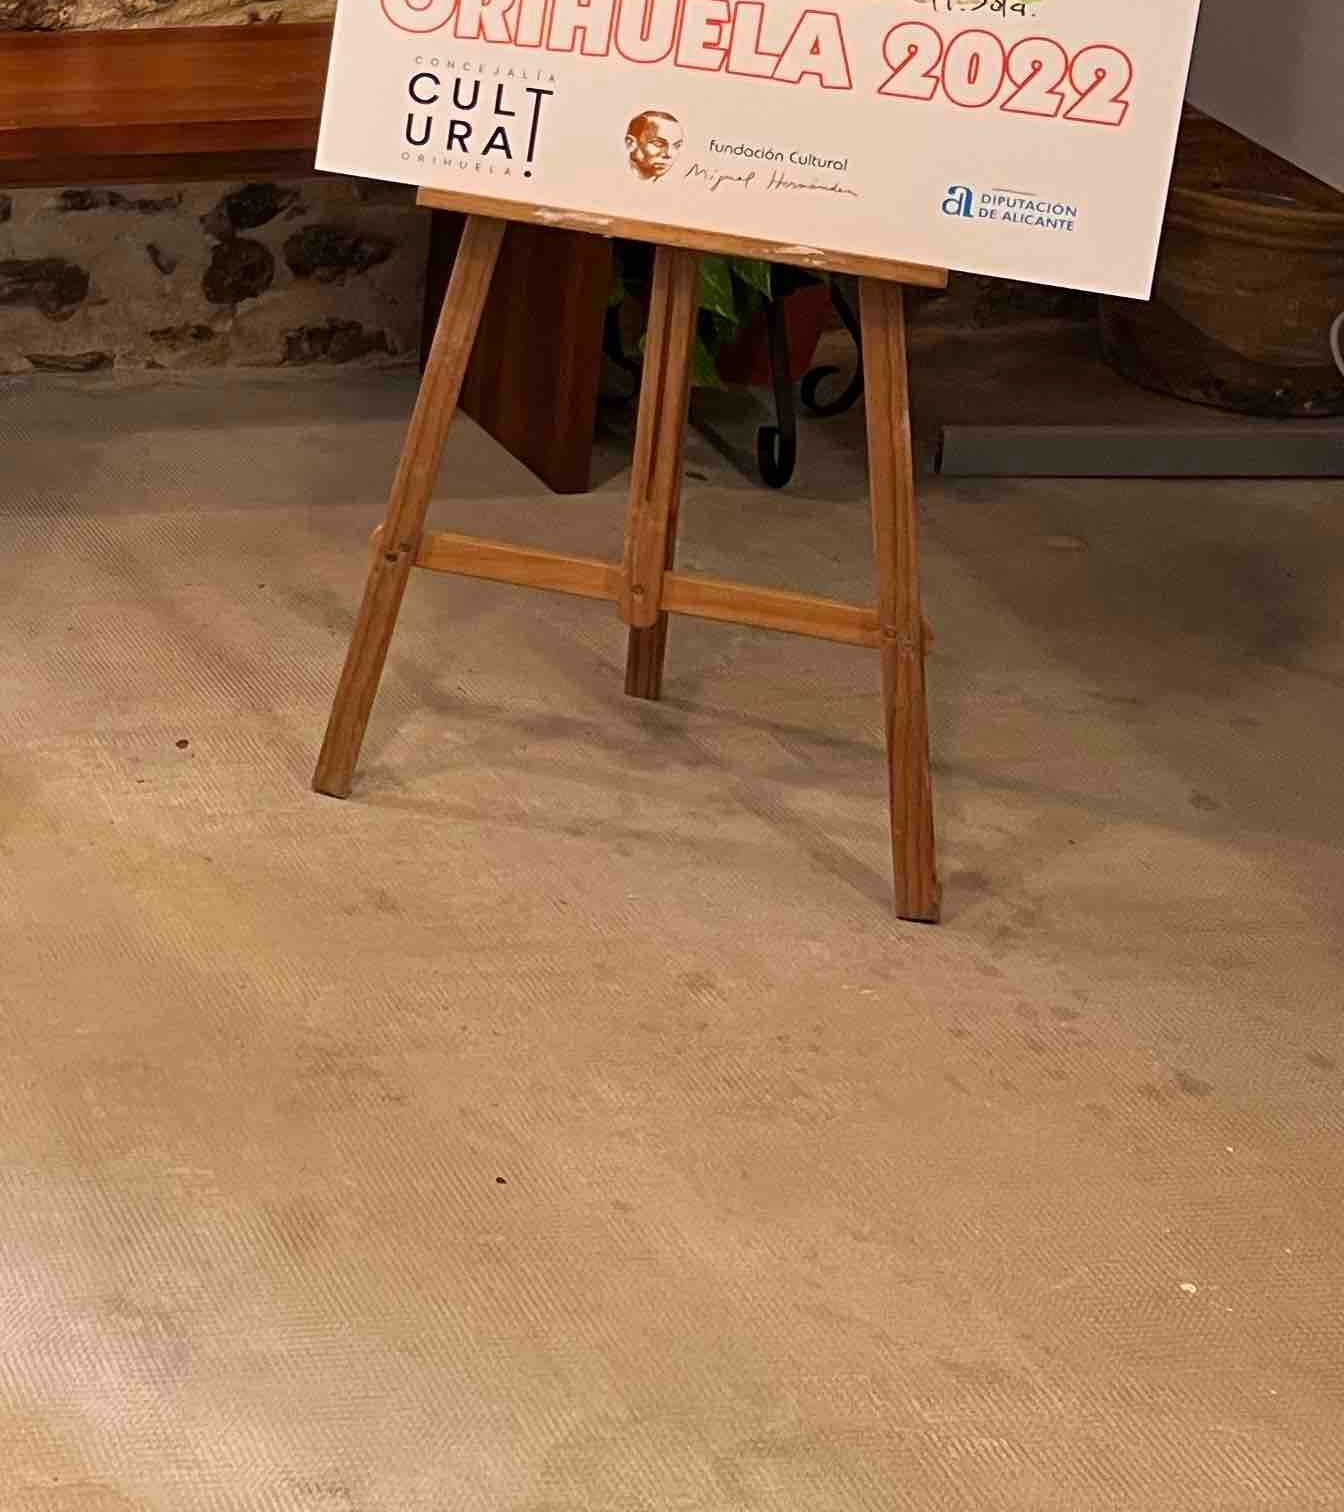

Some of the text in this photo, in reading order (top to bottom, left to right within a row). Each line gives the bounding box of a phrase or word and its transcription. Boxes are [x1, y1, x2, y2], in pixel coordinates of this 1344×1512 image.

[878, 20, 1134, 126] 2022
[400, 151, 512, 177] ORIHUELA
[789, 151, 849, 172] Cultural
[978, 207, 1074, 232] DE ALICANTE
